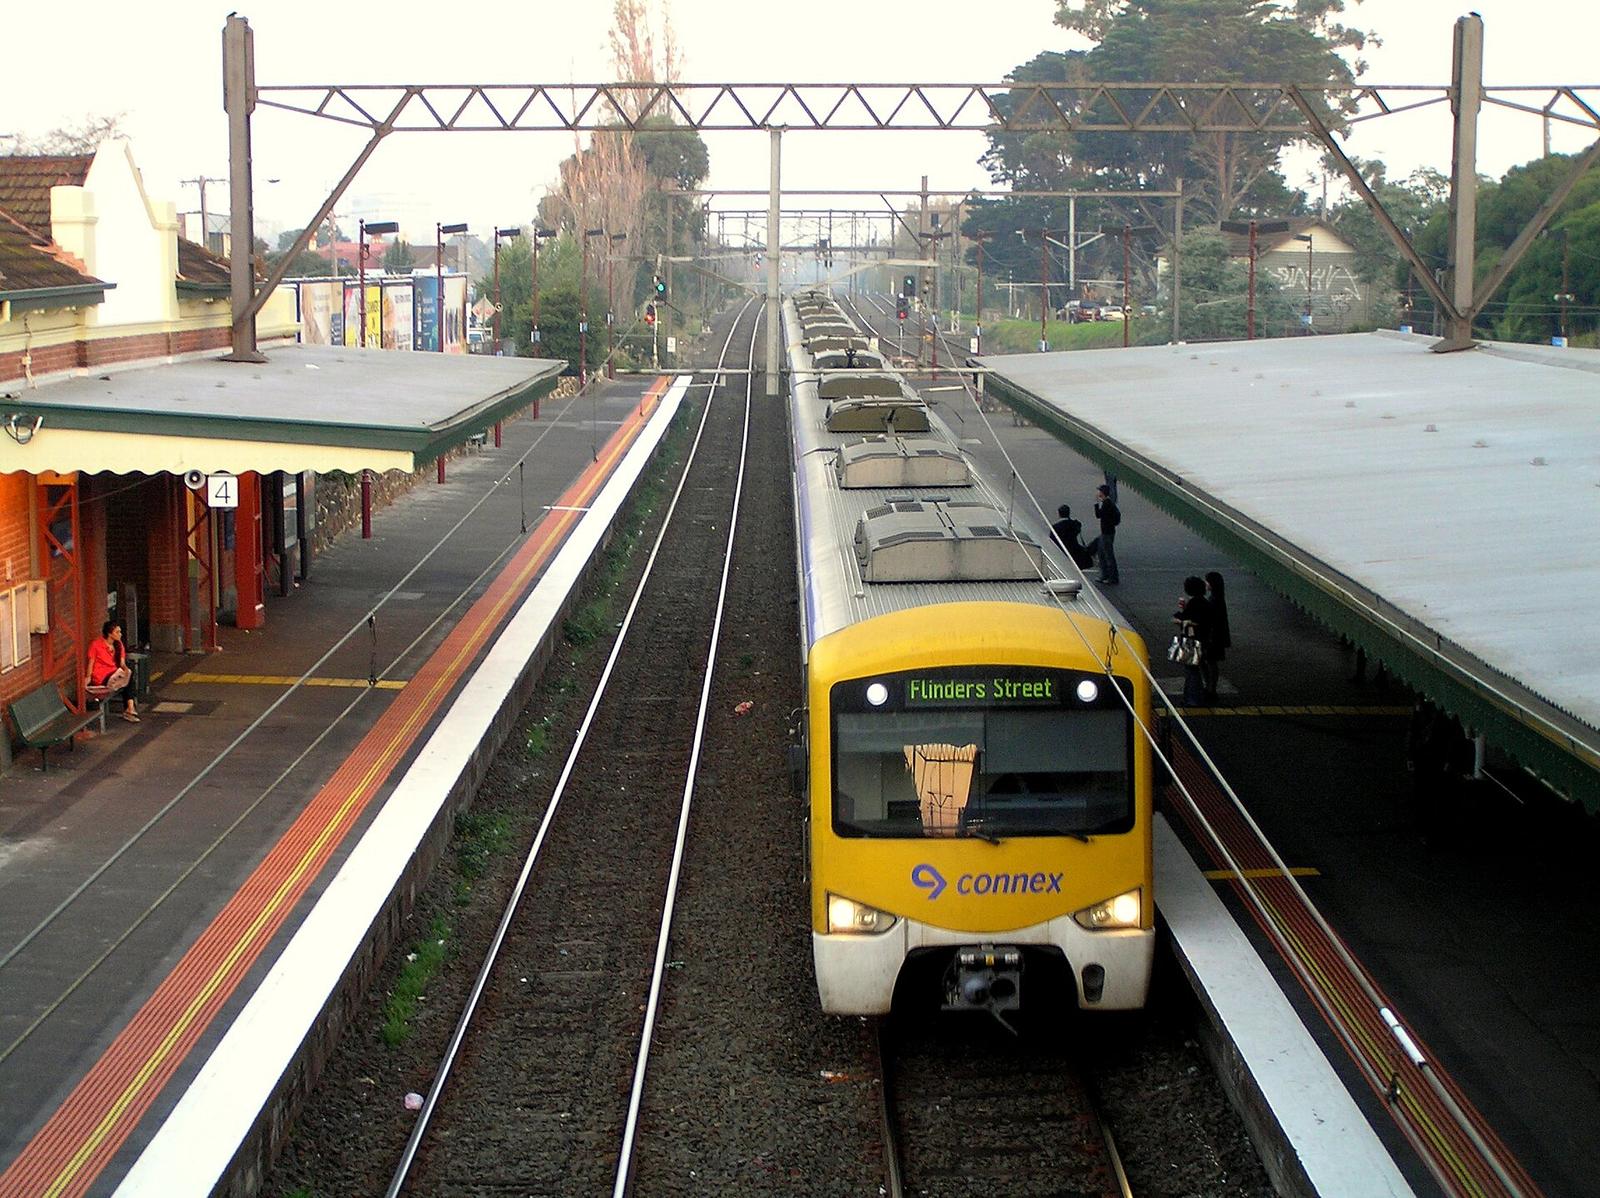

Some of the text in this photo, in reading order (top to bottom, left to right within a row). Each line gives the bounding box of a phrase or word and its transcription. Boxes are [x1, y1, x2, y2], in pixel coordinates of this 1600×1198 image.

[215, 480, 231, 504] 4
[909, 678, 1052, 700] Flinders Street
[957, 872, 1064, 895] connex
